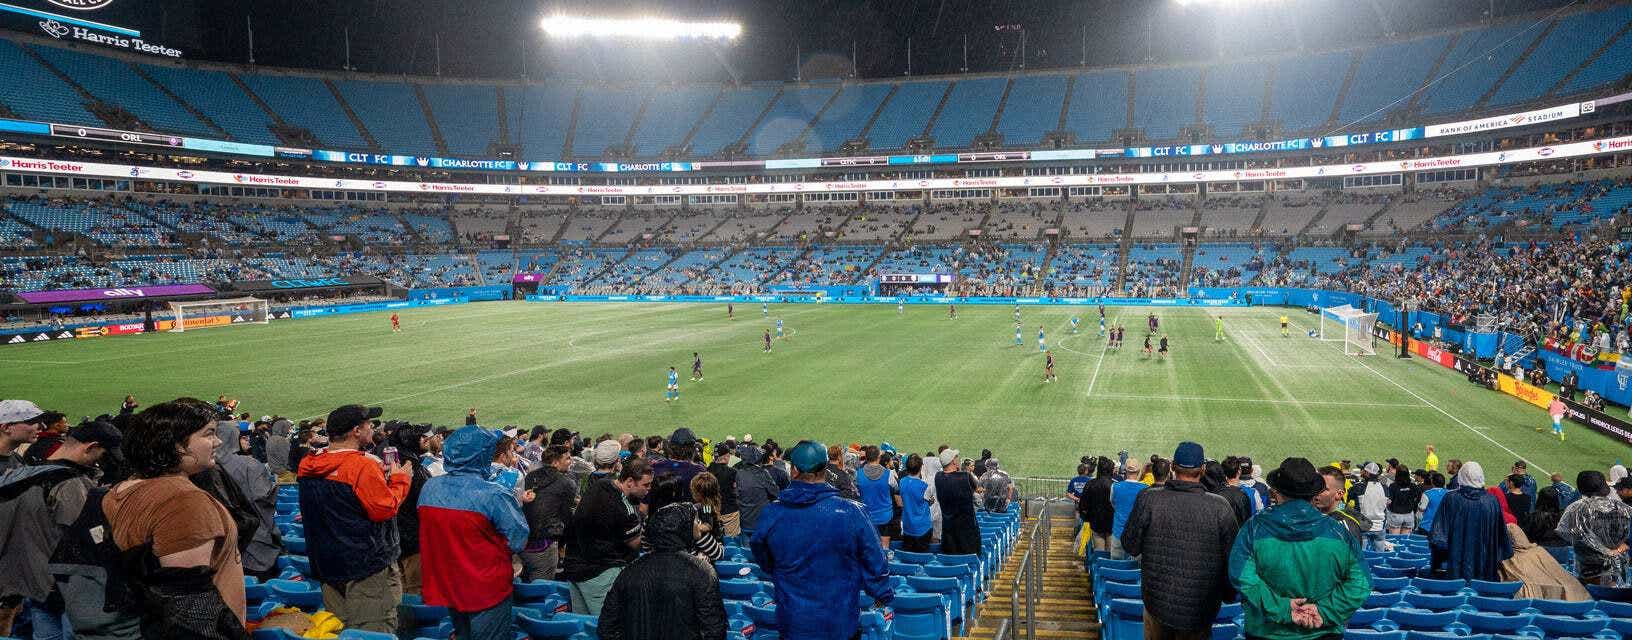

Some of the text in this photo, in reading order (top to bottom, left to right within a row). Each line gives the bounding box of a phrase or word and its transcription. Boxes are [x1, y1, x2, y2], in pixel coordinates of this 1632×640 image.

[73, 26, 182, 57] Harris Teeter
[1474, 120, 1508, 130] AMERICA
[1528, 112, 1563, 122] STADIUM
[121, 133, 142, 142] ORL
[1351, 132, 1389, 144] CLT FC
[1236, 139, 1299, 152] CHARLOTTE FC
[1154, 146, 1187, 156] CLT FC
[349, 153, 388, 164] CLT FC
[442, 159, 505, 168] CHARLOTTE FC
[12, 160, 83, 172] Harris Teeter
[557, 162, 588, 171] CLT FC
[620, 163, 660, 171] CHARLOTTE
[104, 288, 145, 297] ally
